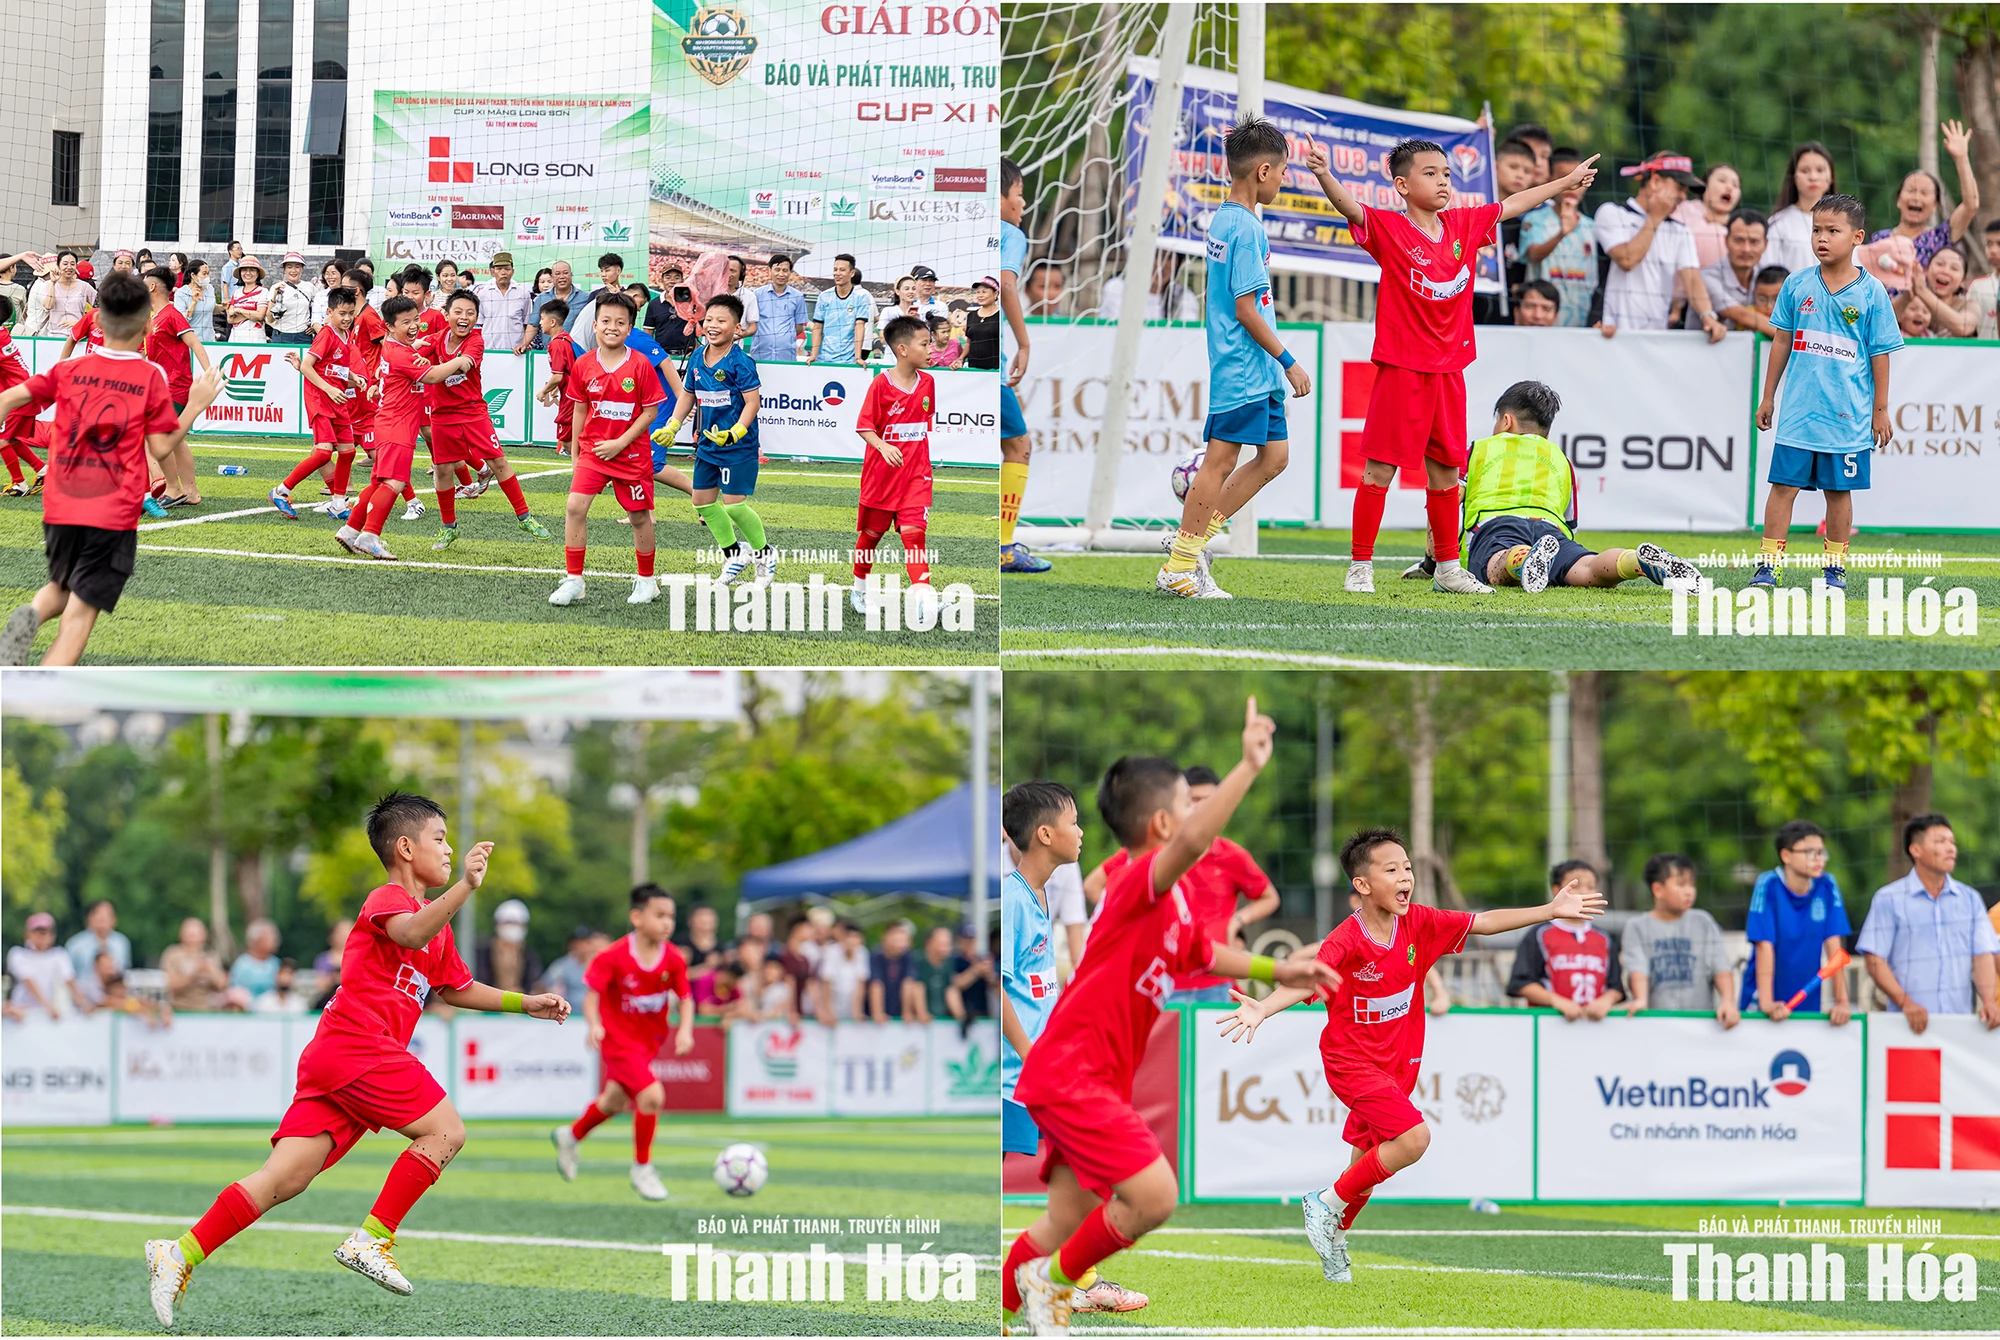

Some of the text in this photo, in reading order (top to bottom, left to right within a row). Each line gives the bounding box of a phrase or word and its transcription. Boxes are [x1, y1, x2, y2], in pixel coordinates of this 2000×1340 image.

[765, 58, 999, 90] BÁO VÀ PHÁT THANH, TRU
[858, 102, 933, 122] CUP
[944, 104, 975, 122] XI
[477, 162, 593, 177] LONG SON
[784, 201, 809, 214] TH
[900, 201, 959, 213] VICEM
[389, 211, 432, 220] VietinBank
[552, 225, 578, 240] TH
[417, 239, 477, 252] VICEM
[1807, 342, 1855, 358] LONG SON
[72, 376, 100, 387] NAM
[206, 402, 283, 422] MINH TUẤN
[600, 408, 618, 417] LONG
[936, 412, 995, 426] LONG
[788, 417, 815, 426] Thanh
[818, 419, 837, 427] Hóa
[1622, 436, 1734, 471] SON
[1924, 437, 1981, 457] SƠN
[1844, 454, 1857, 477] 5
[629, 485, 644, 501] 12
[1381, 1002, 1408, 1017] LONG
[1596, 1076, 1770, 1108] VietinBank
[1610, 1122, 1796, 1140] Chi nhánh Thanh Hóa
